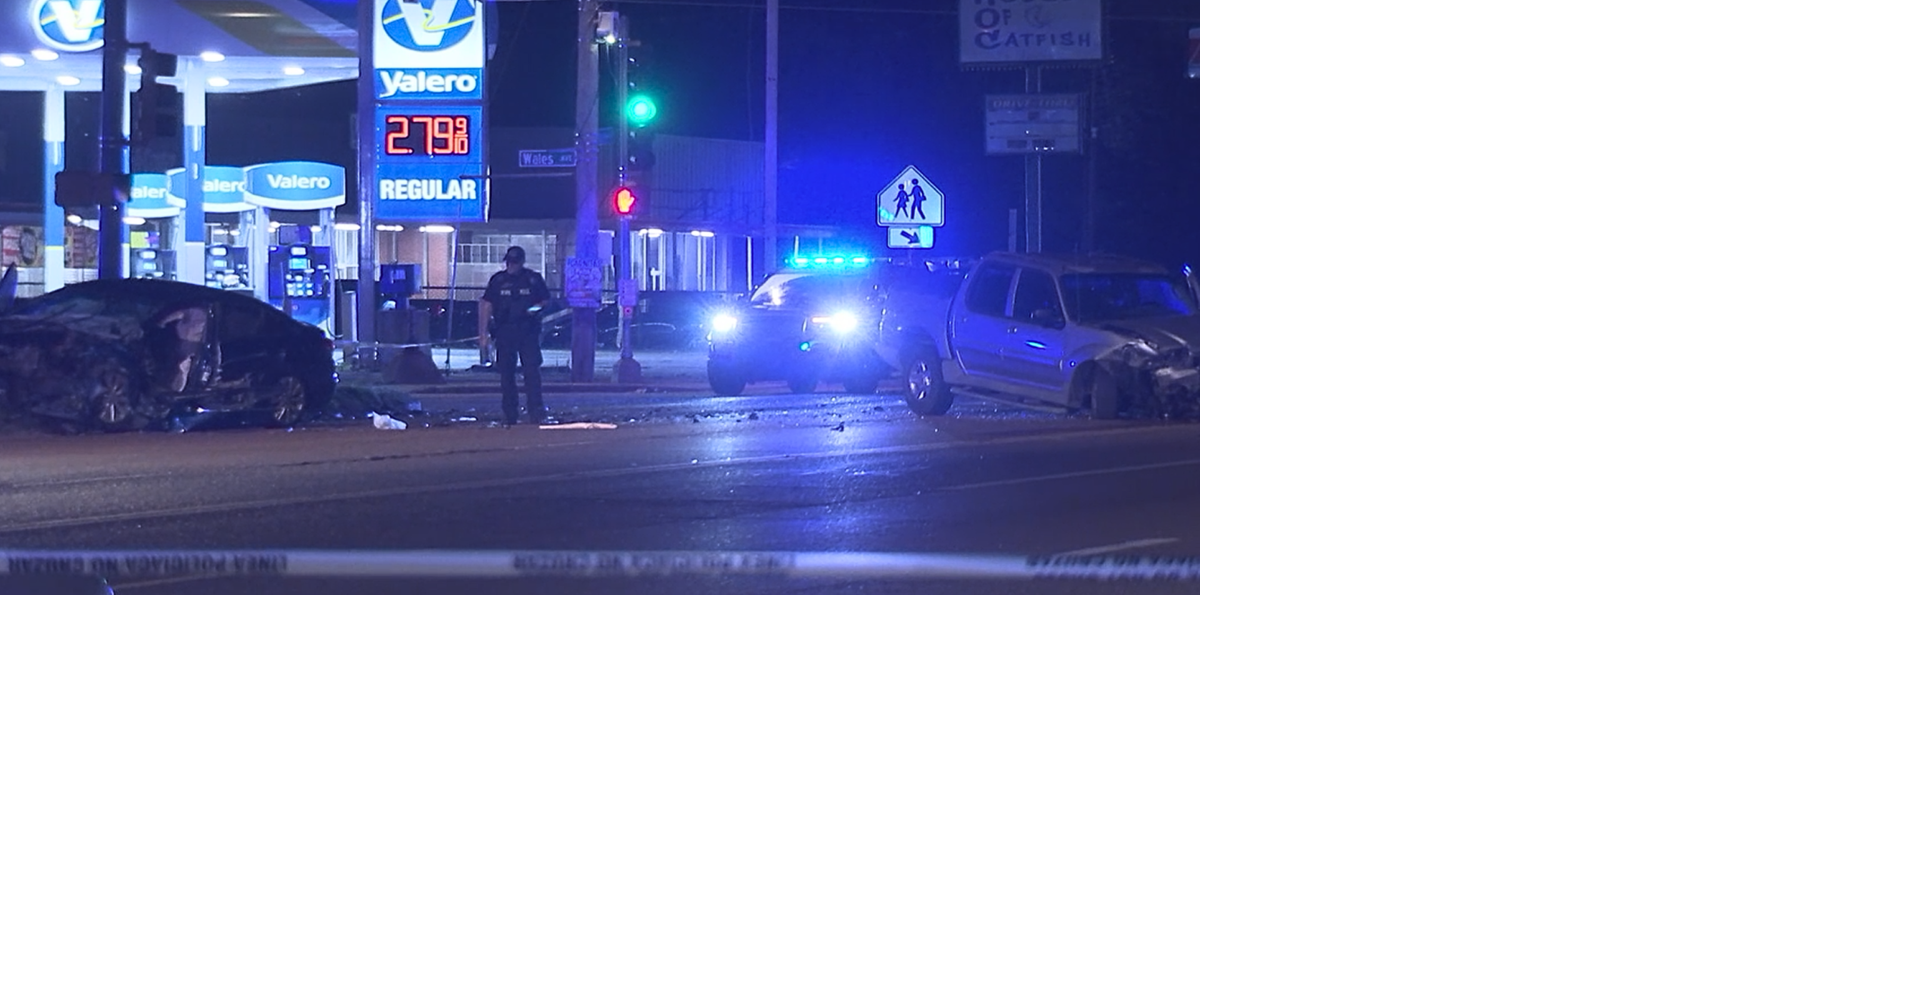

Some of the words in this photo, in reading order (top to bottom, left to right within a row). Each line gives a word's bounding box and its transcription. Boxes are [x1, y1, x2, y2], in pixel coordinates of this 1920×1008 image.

[974, 8, 1011, 28] OF
[974, 30, 1091, 49] CATFISH
[522, 152, 554, 165] Wales
[204, 179, 245, 193] alero
[267, 173, 330, 189] Valero
[131, 186, 167, 199] aler
[380, 179, 477, 200] REGULAR
